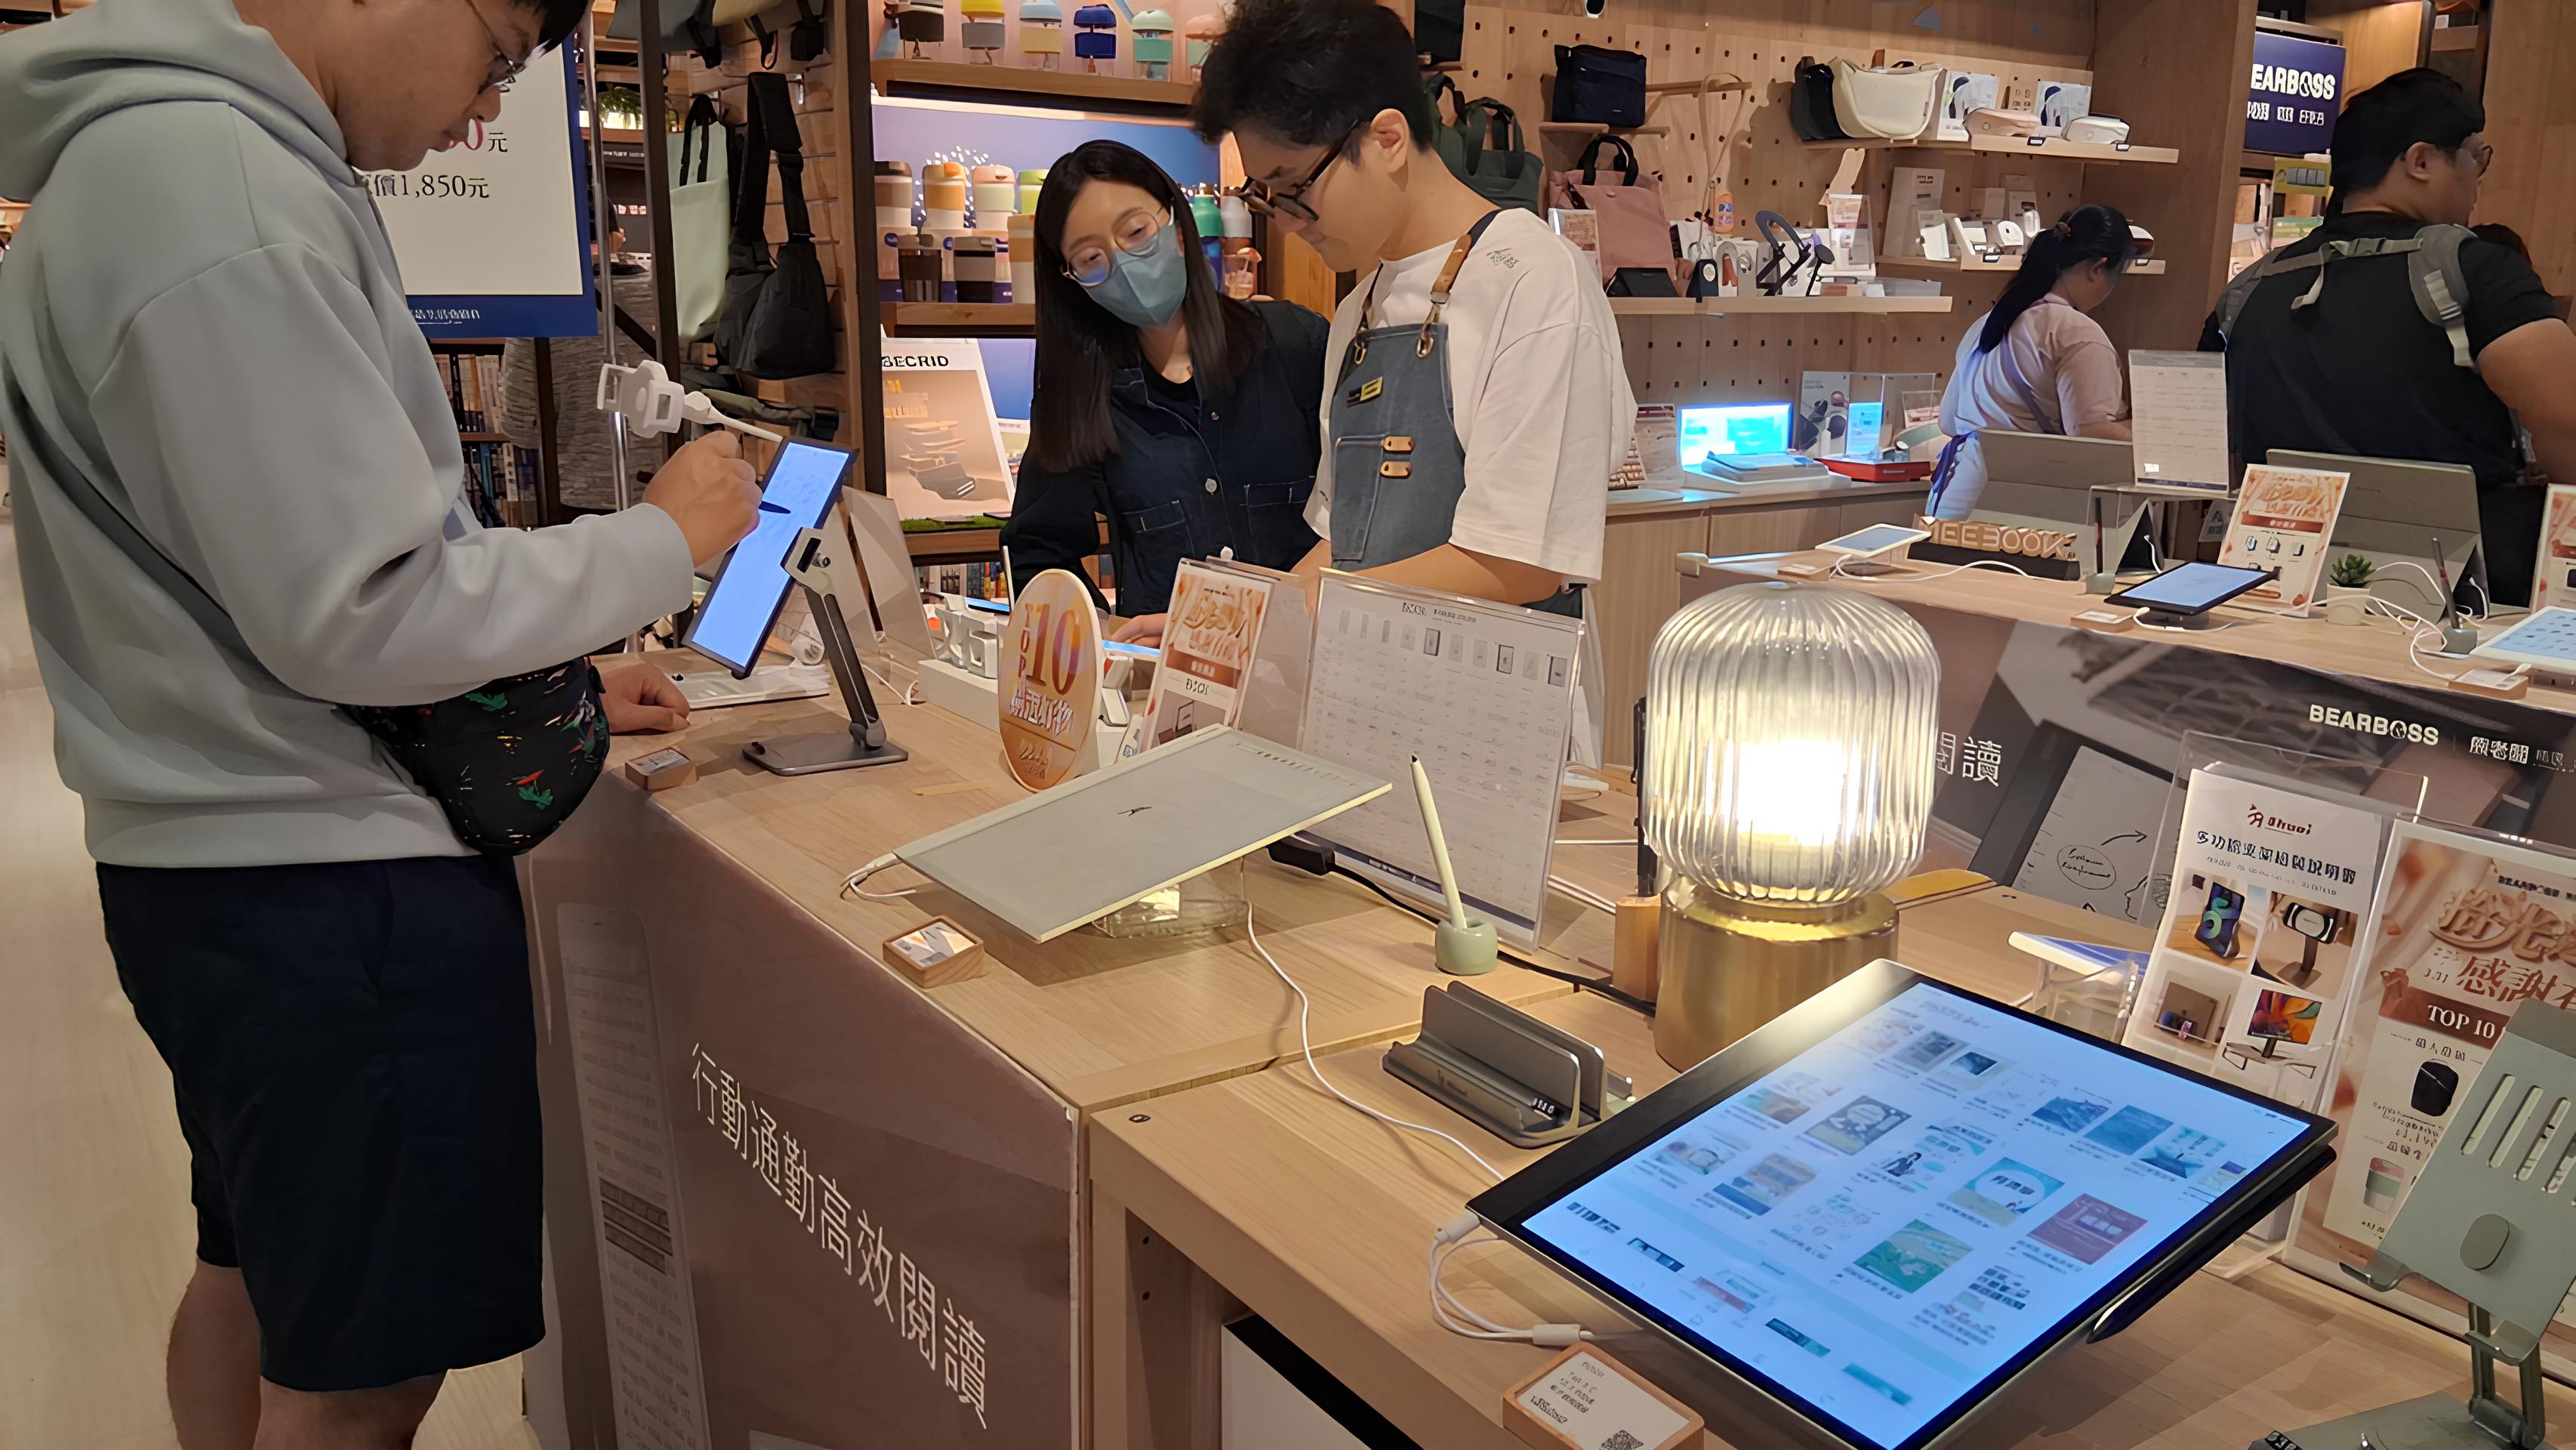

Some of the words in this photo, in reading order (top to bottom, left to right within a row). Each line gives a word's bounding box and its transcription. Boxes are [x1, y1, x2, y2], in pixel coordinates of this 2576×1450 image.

[2251, 63, 2336, 100] EARBOSS
[1025, 603, 1081, 696] 10
[2309, 704, 2439, 745] BEARBOSS
[2428, 1004, 2470, 1030] TOP
[2474, 1020, 2495, 1039] 10
[692, 1043, 987, 1430] 行動通勤高效閱讀
